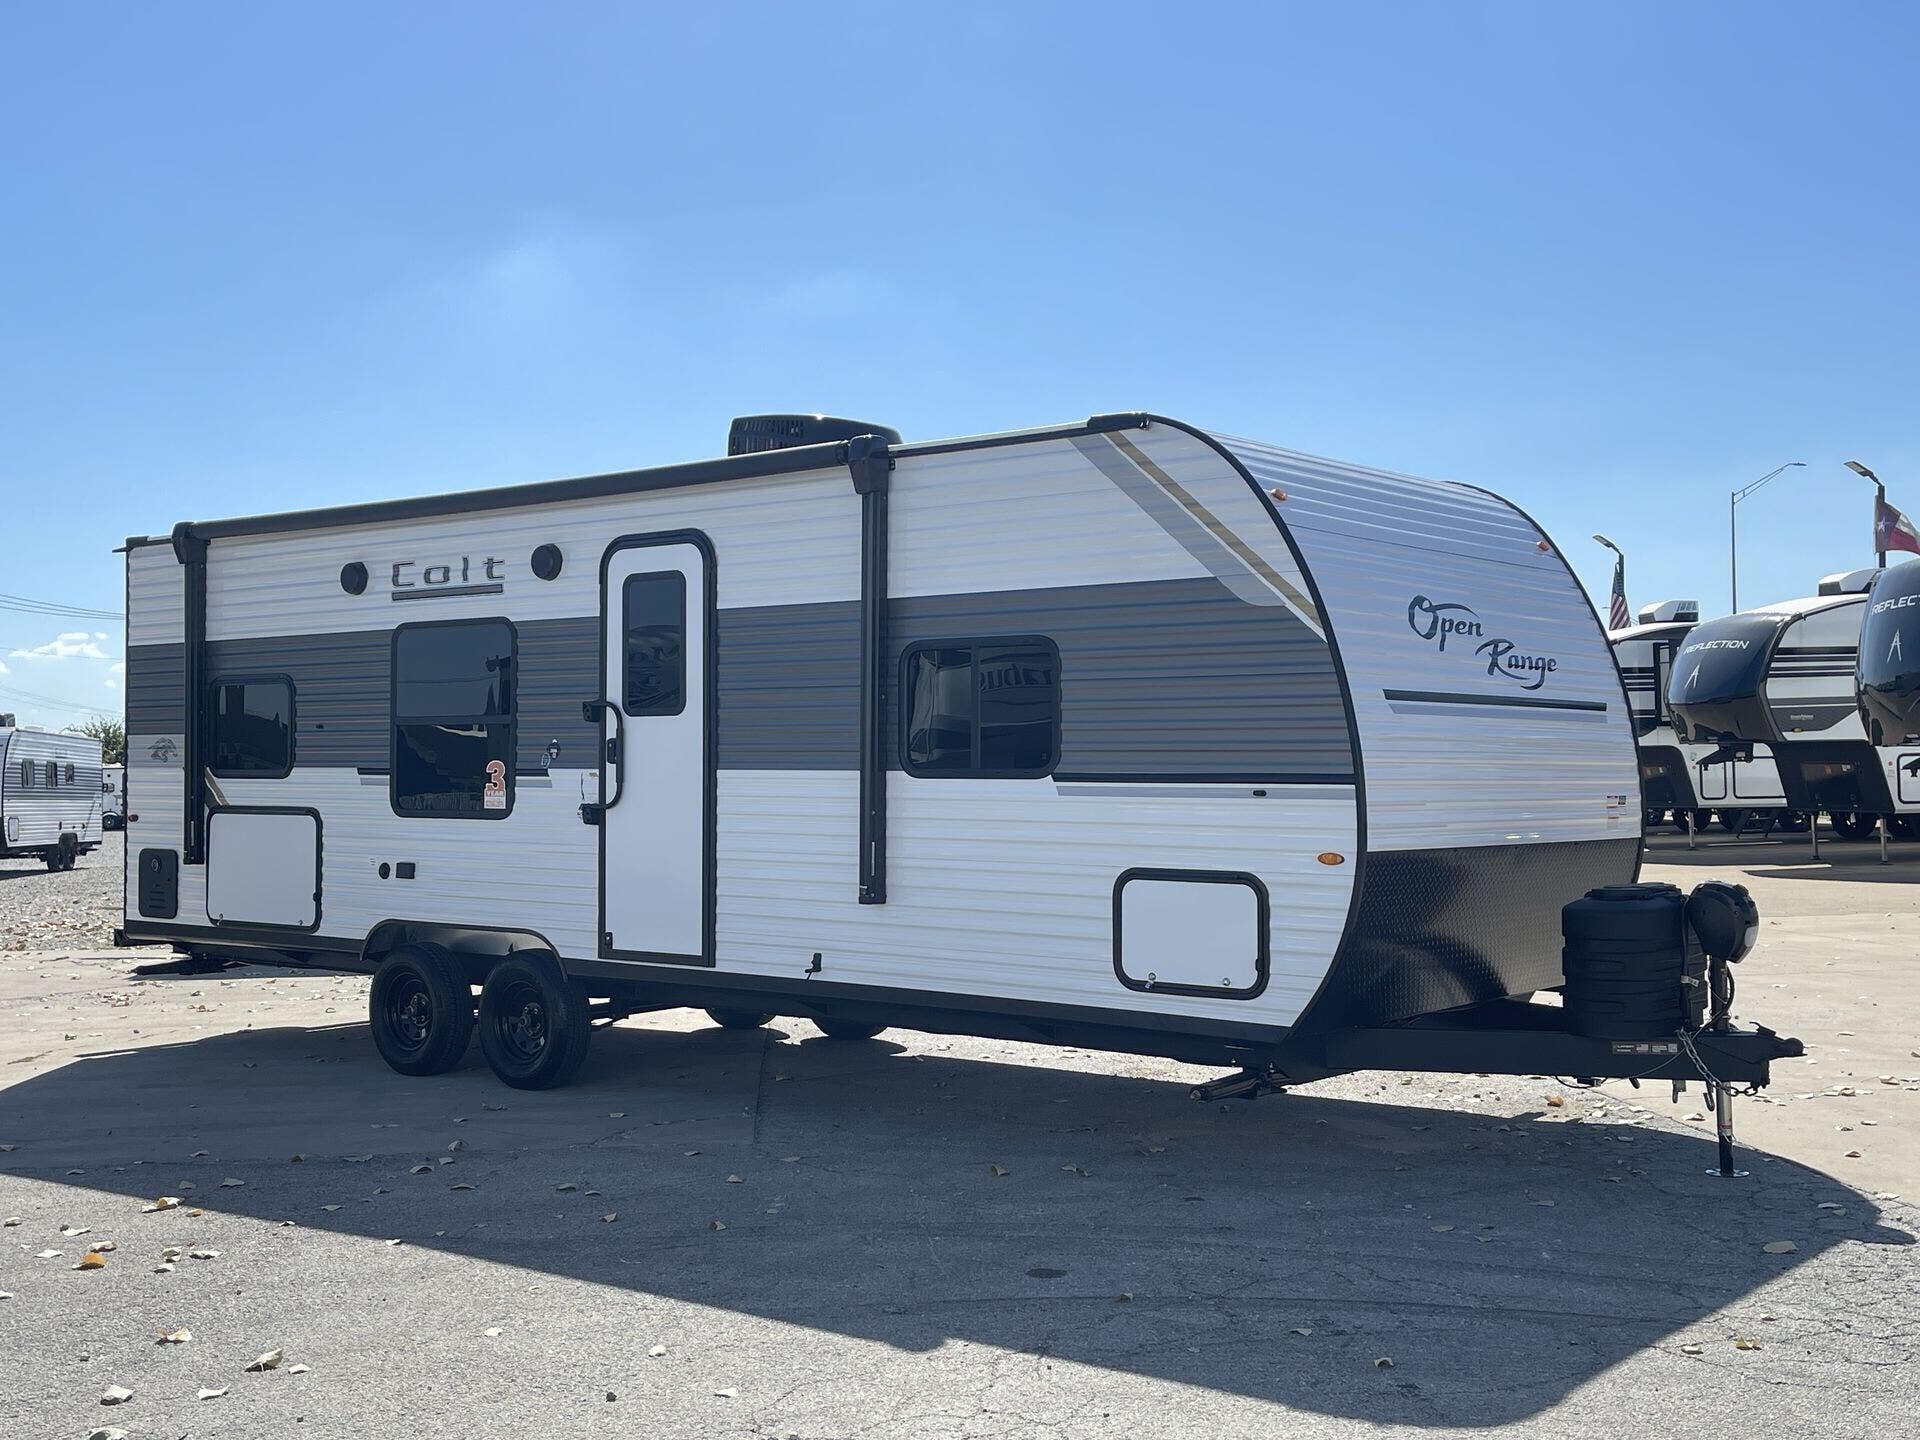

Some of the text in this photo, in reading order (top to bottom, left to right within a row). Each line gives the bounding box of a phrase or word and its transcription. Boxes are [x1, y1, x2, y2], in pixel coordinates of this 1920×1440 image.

[392, 556, 505, 587] Colt
[1871, 594, 1920, 615] REFLEC
[1408, 594, 1484, 651] Open
[1683, 640, 1750, 655] REFLECTION
[1475, 638, 1558, 690] Range
[486, 760, 506, 791] 3
